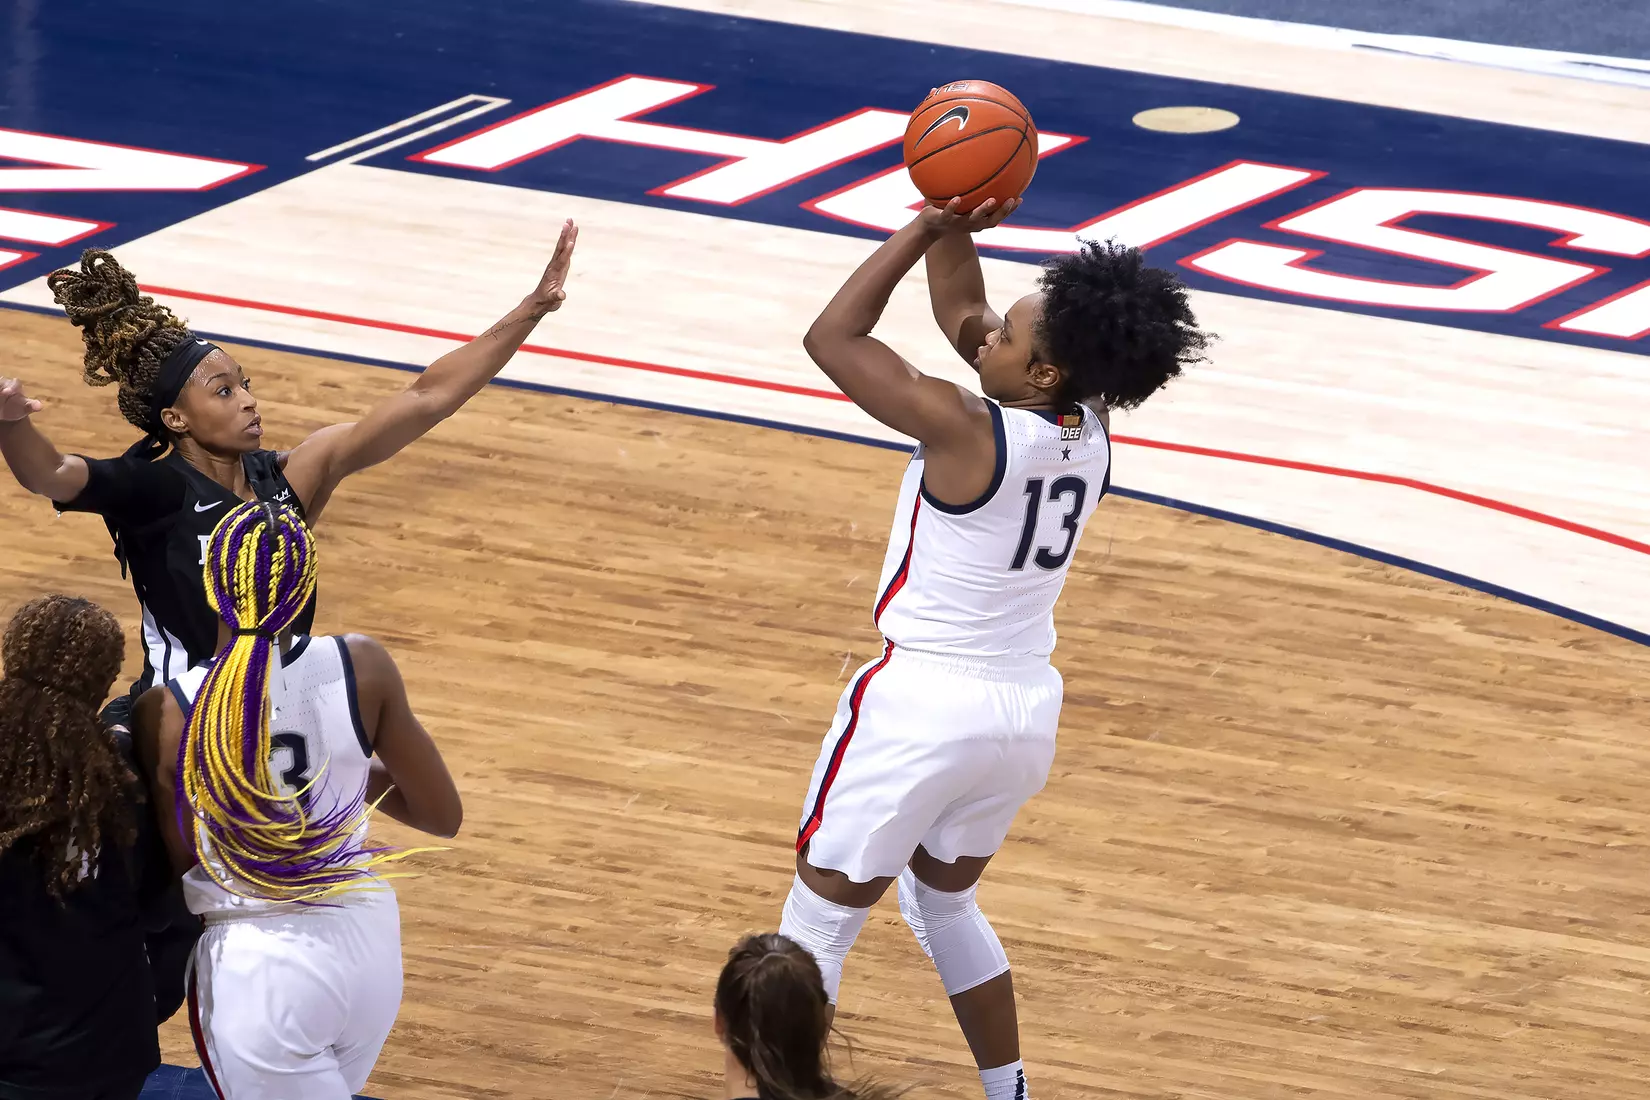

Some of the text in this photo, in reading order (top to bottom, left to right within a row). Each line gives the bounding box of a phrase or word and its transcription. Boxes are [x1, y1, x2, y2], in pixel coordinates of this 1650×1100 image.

[405, 74, 1650, 341] HUS
[1061, 427, 1081, 440] DEE
[1007, 473, 1089, 572] 13
